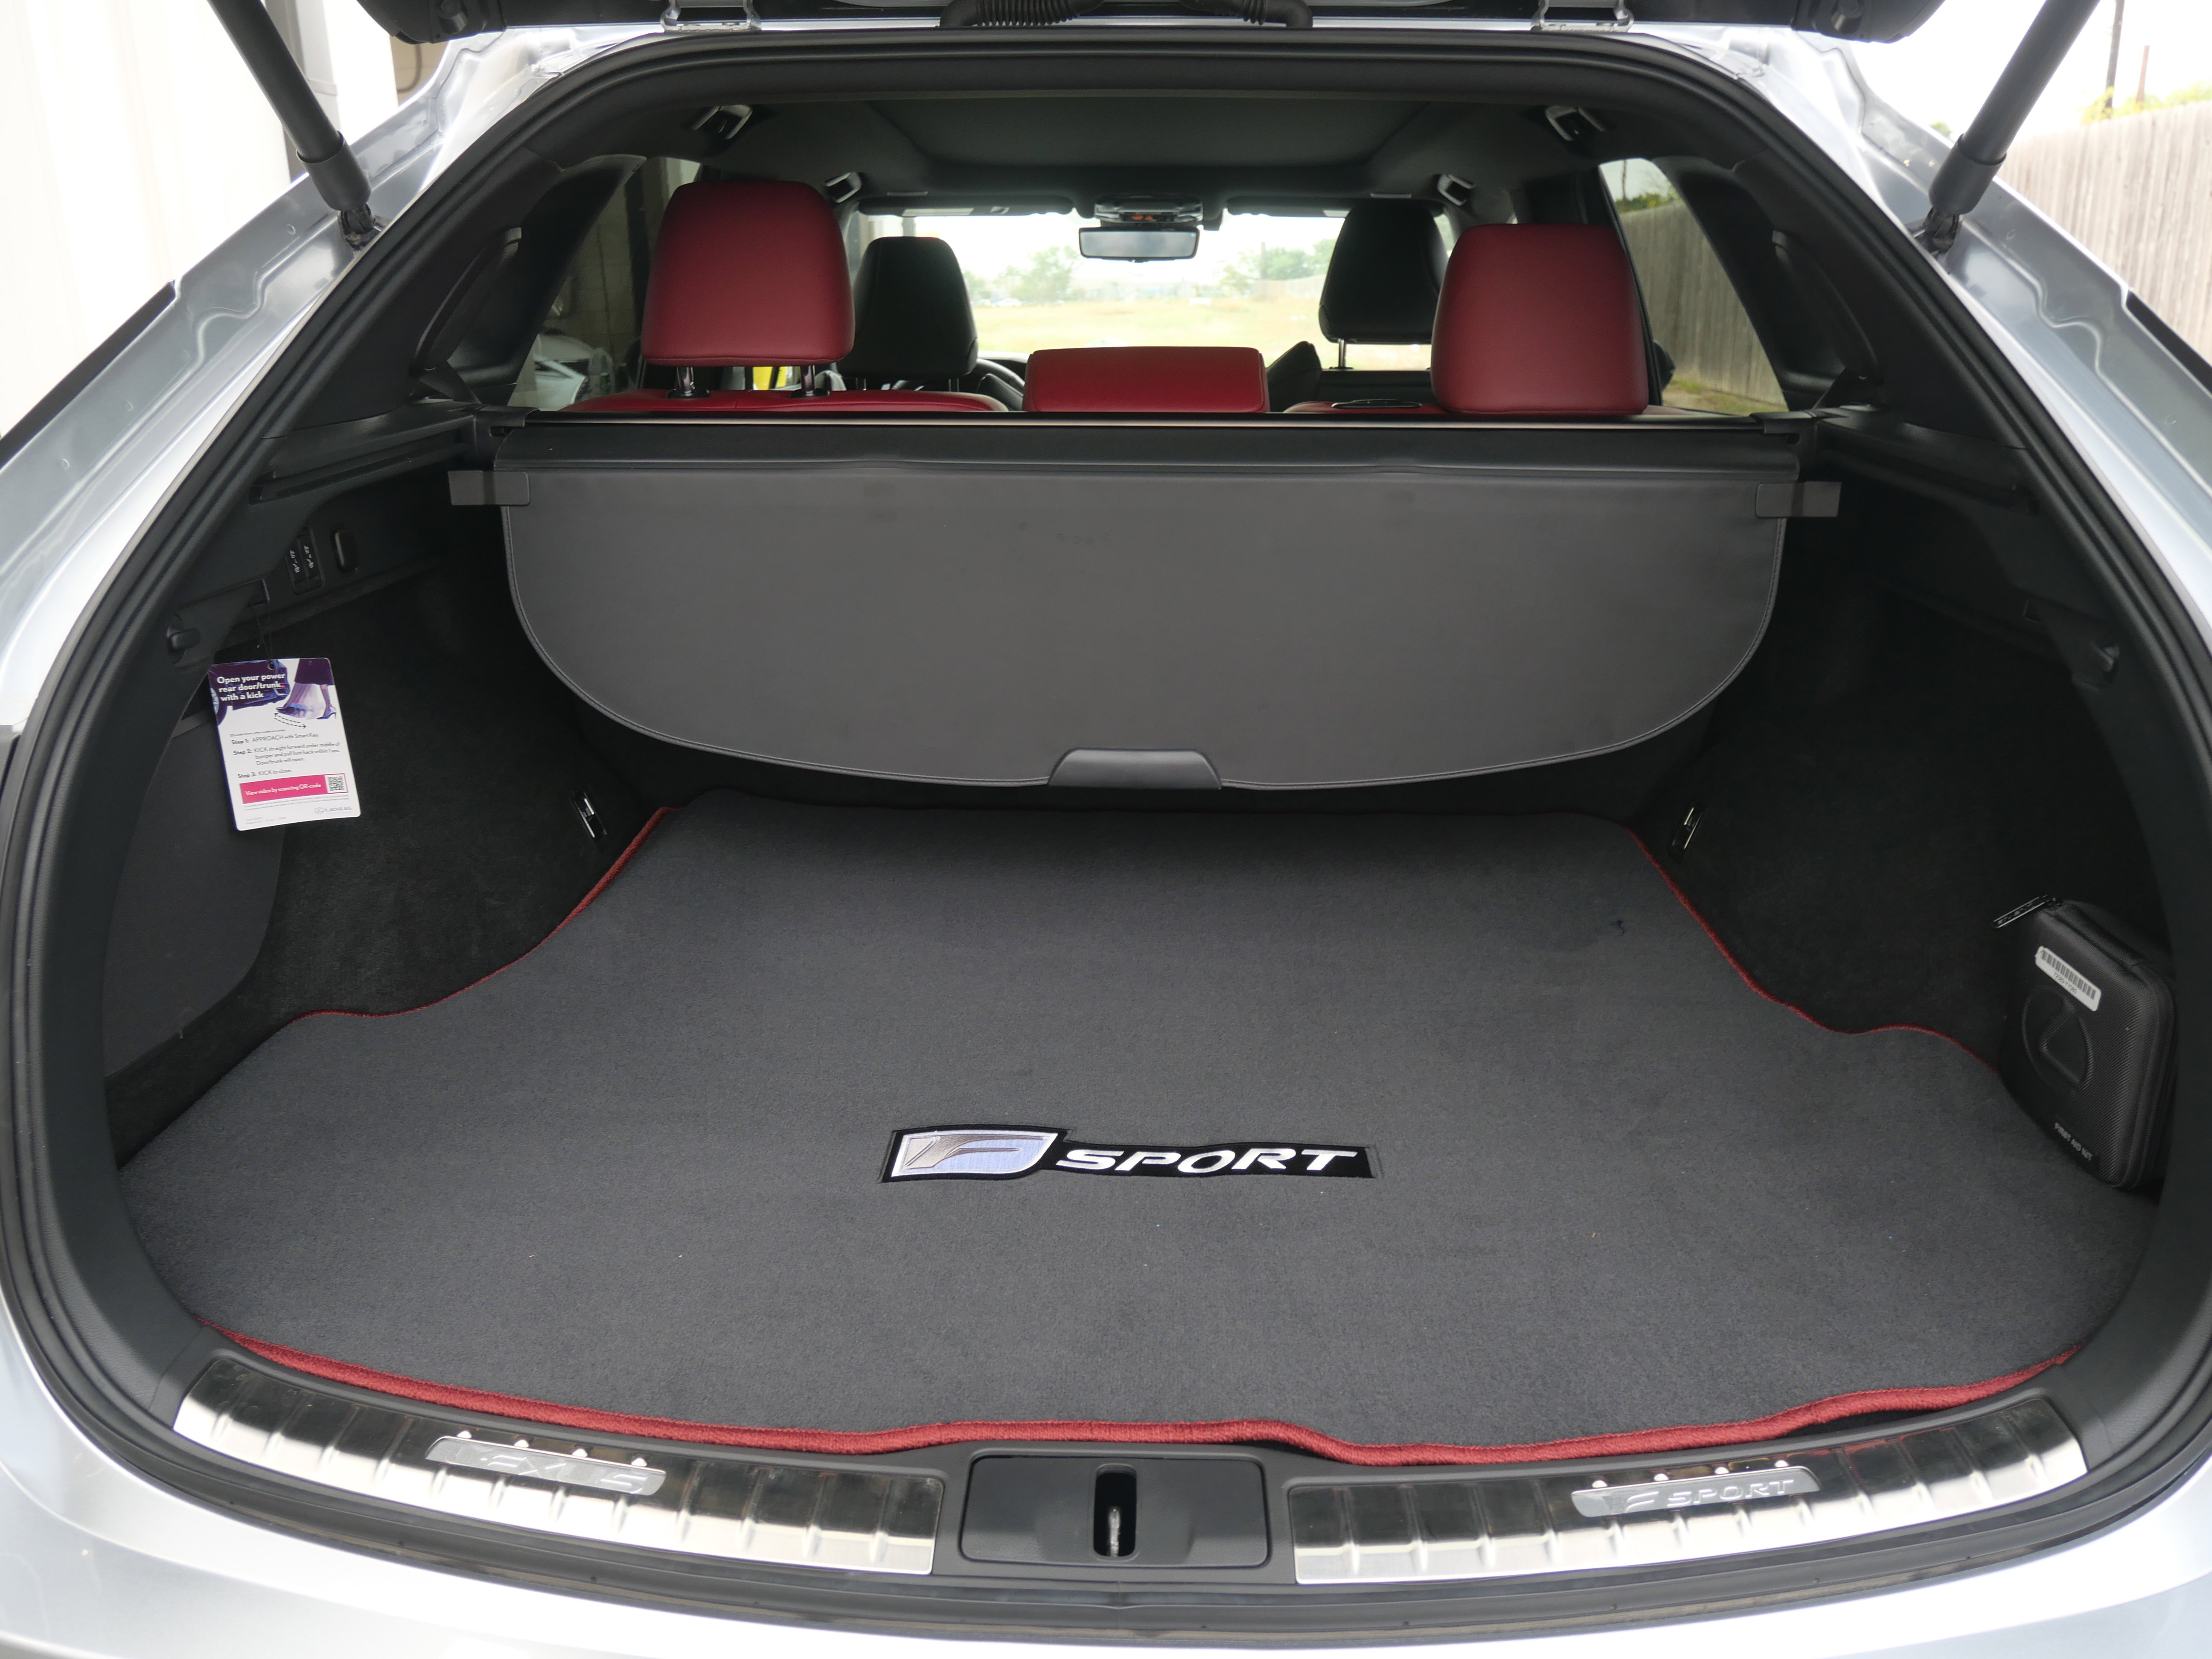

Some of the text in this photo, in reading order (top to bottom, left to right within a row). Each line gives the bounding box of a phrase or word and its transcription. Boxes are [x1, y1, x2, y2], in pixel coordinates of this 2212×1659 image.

[238, 681, 281, 690] door/trunk
[1056, 1147, 1356, 1174] SPORT
[1667, 1479, 1794, 1507] SPORT
